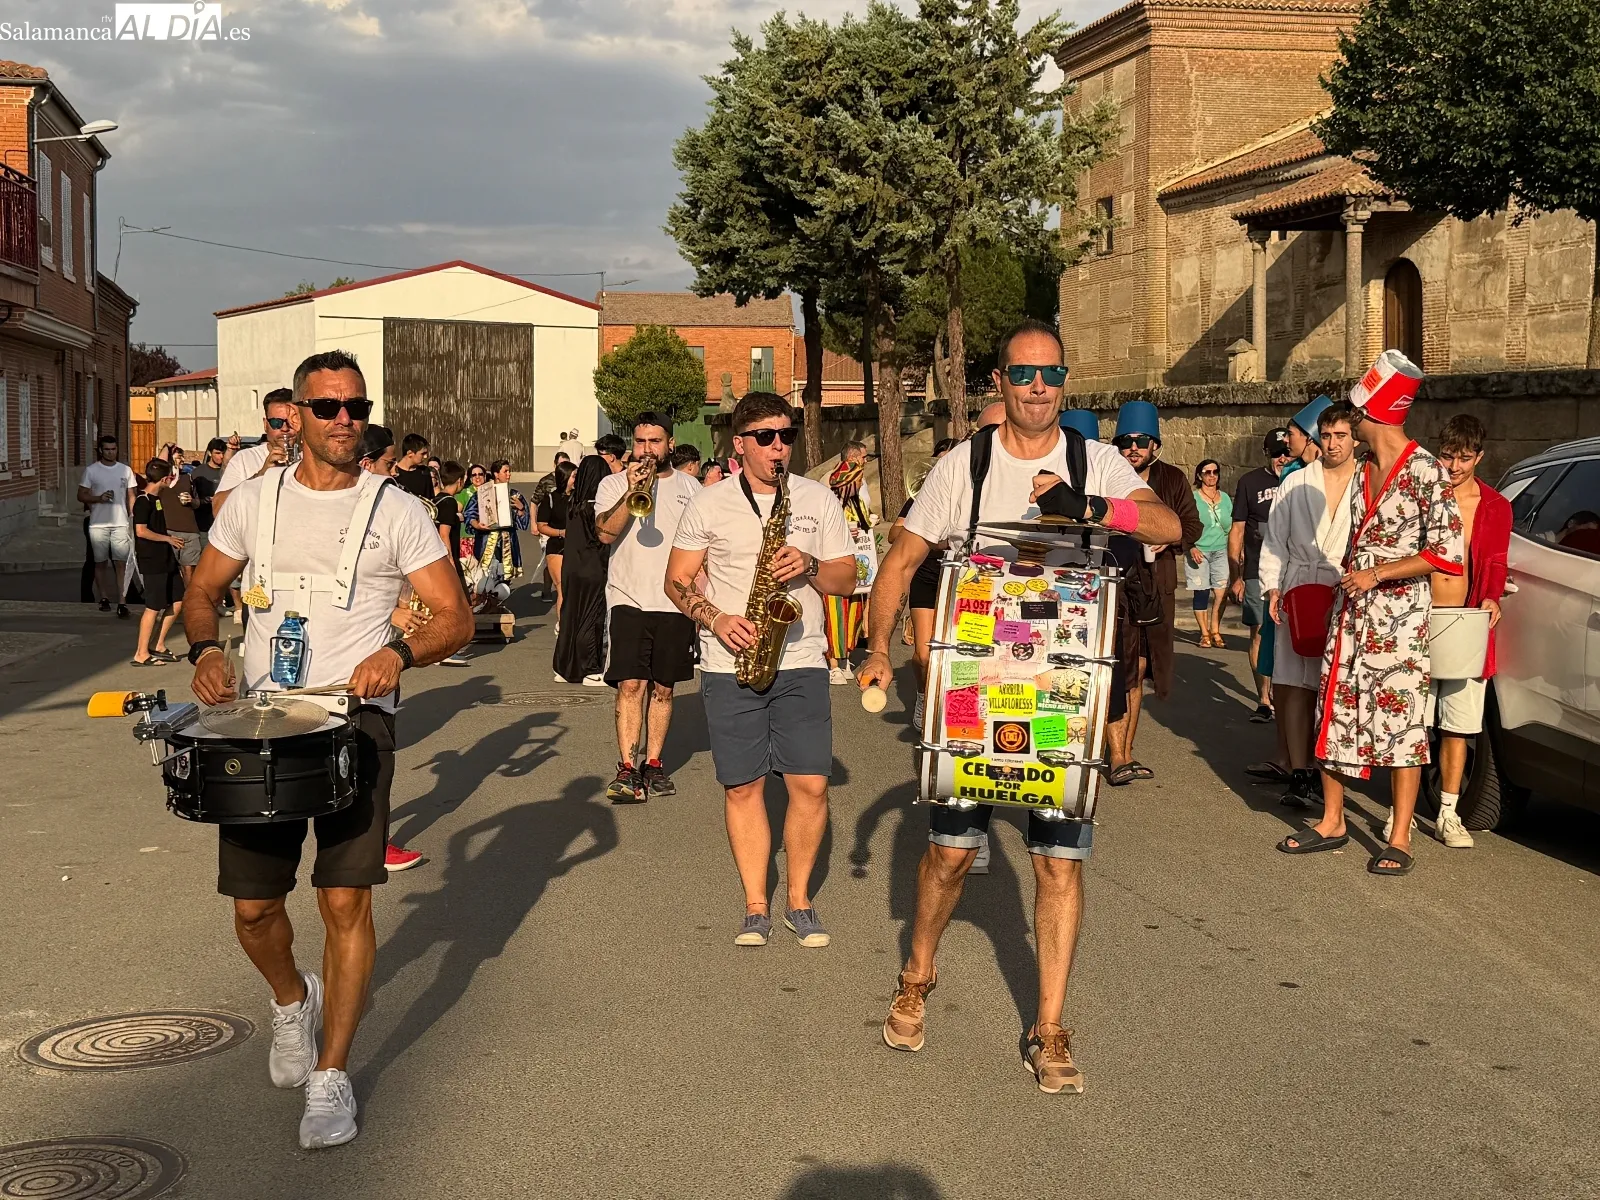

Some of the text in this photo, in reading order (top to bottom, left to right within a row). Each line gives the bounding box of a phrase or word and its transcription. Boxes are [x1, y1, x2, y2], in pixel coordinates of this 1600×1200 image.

[960, 598, 971, 610] LA
[994, 780, 1021, 791] POR
[959, 785, 1055, 806] HUELGA
